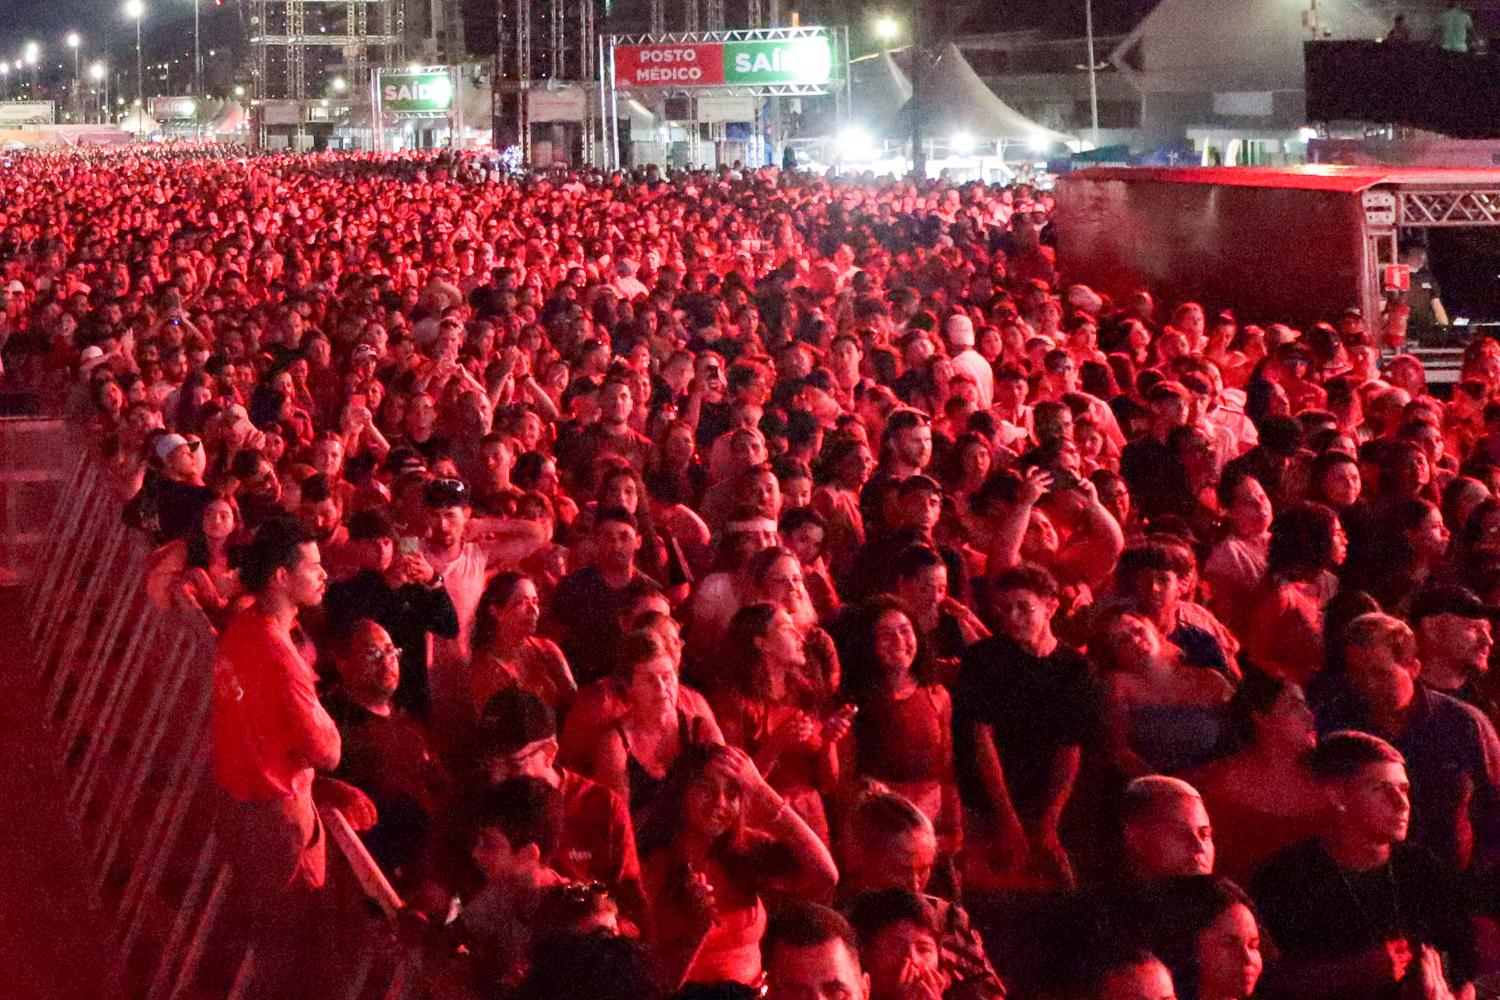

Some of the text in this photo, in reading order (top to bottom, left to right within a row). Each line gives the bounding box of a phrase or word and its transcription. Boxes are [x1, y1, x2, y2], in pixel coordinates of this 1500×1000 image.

[639, 48, 697, 63] POSTO
[735, 47, 820, 72] SAÍ
[636, 65, 702, 82] MÉDICO
[385, 80, 446, 101] SAÍD
